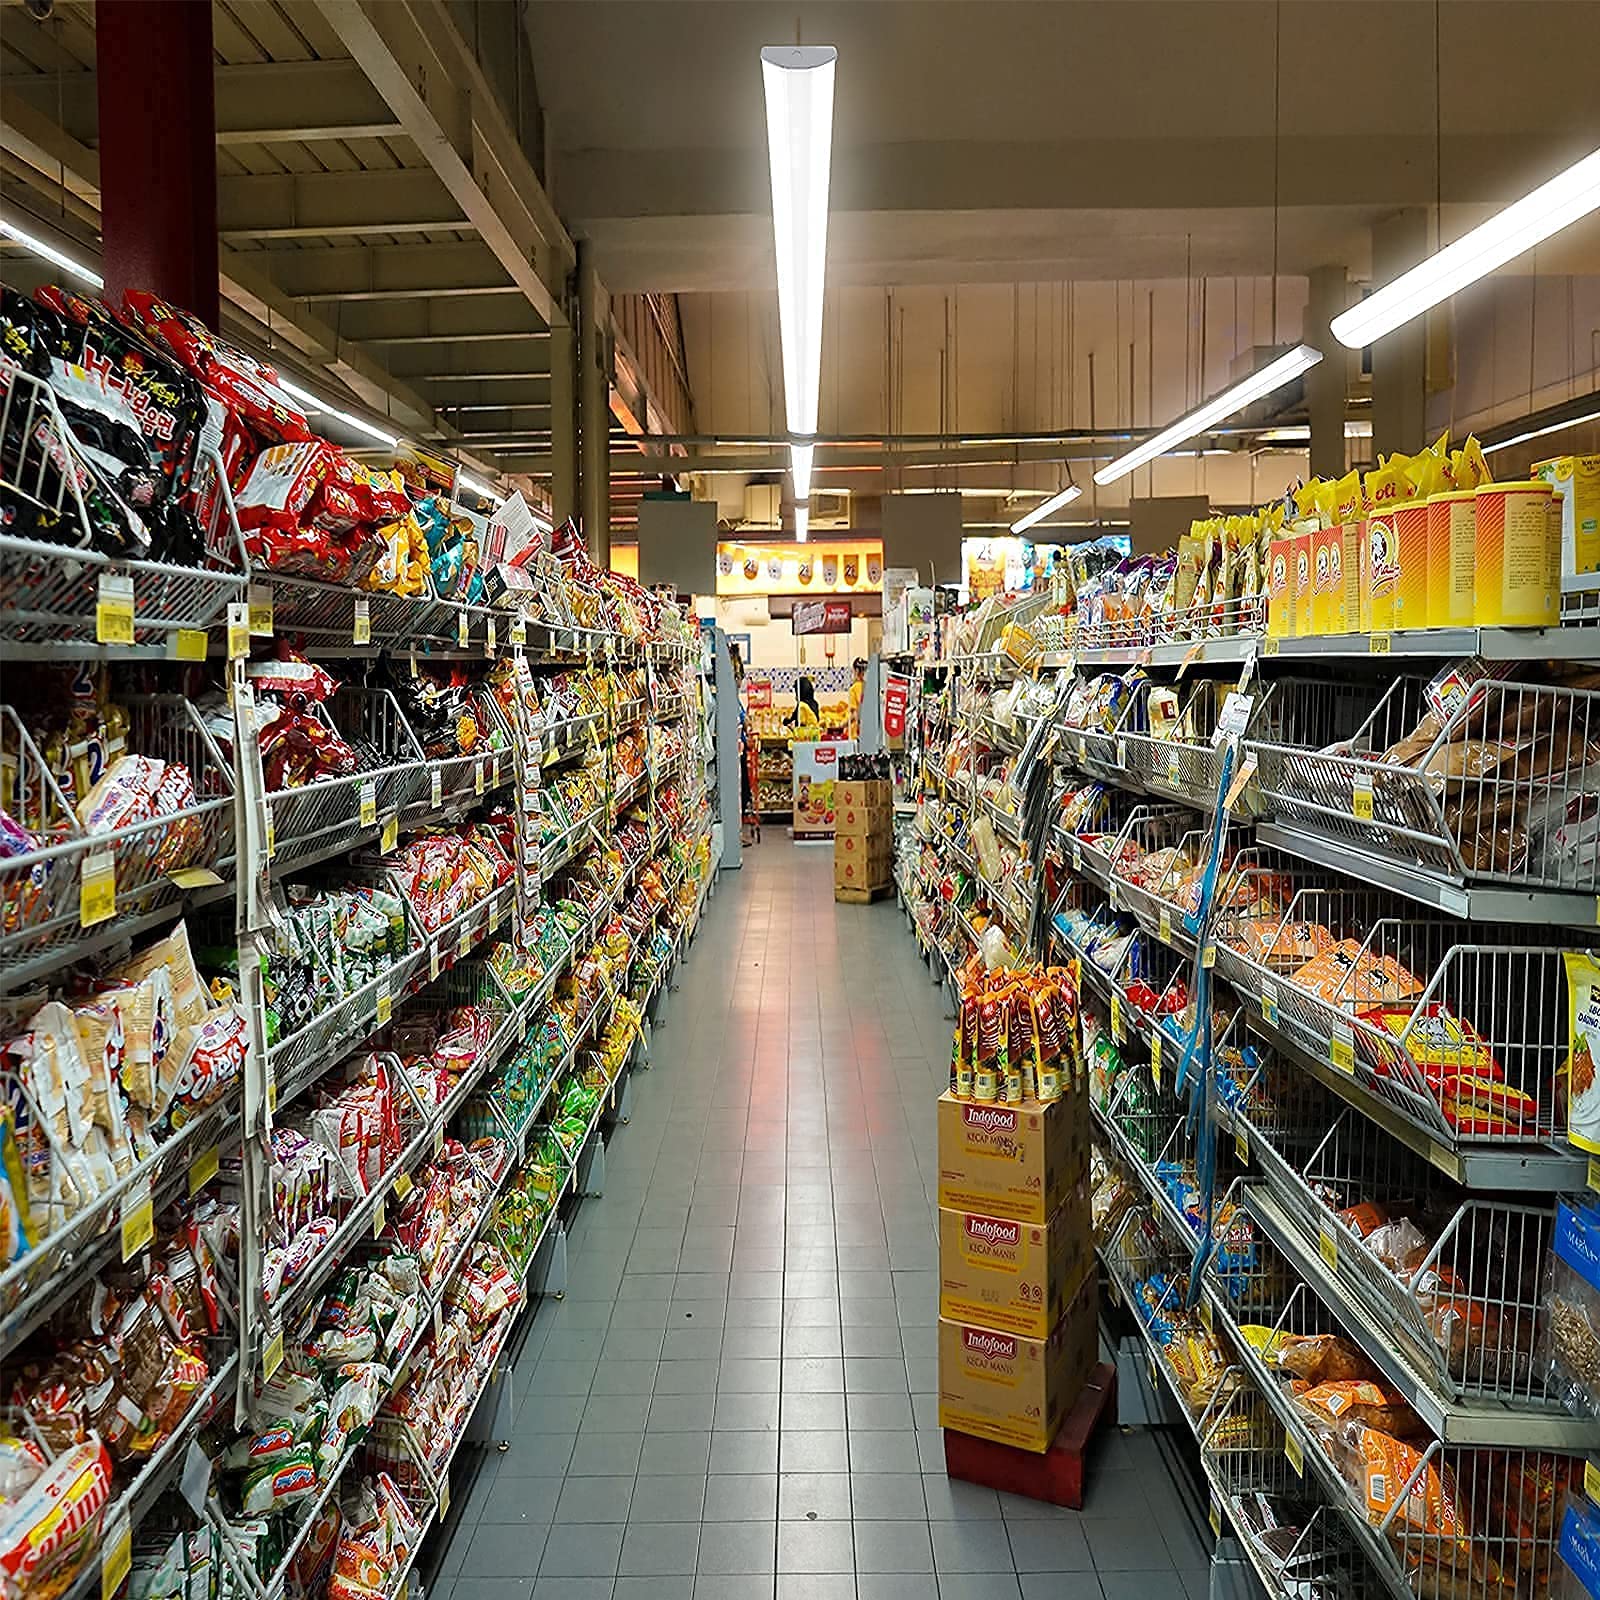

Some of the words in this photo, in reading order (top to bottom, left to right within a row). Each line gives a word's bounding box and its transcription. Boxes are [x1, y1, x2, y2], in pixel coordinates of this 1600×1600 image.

[968, 1108, 1015, 1128] Indofood
[970, 1219, 1017, 1241] Indofood
[968, 1244, 992, 1254] KECAP
[992, 1248, 1016, 1259] MANIS
[967, 1333, 1014, 1354] Indofood
